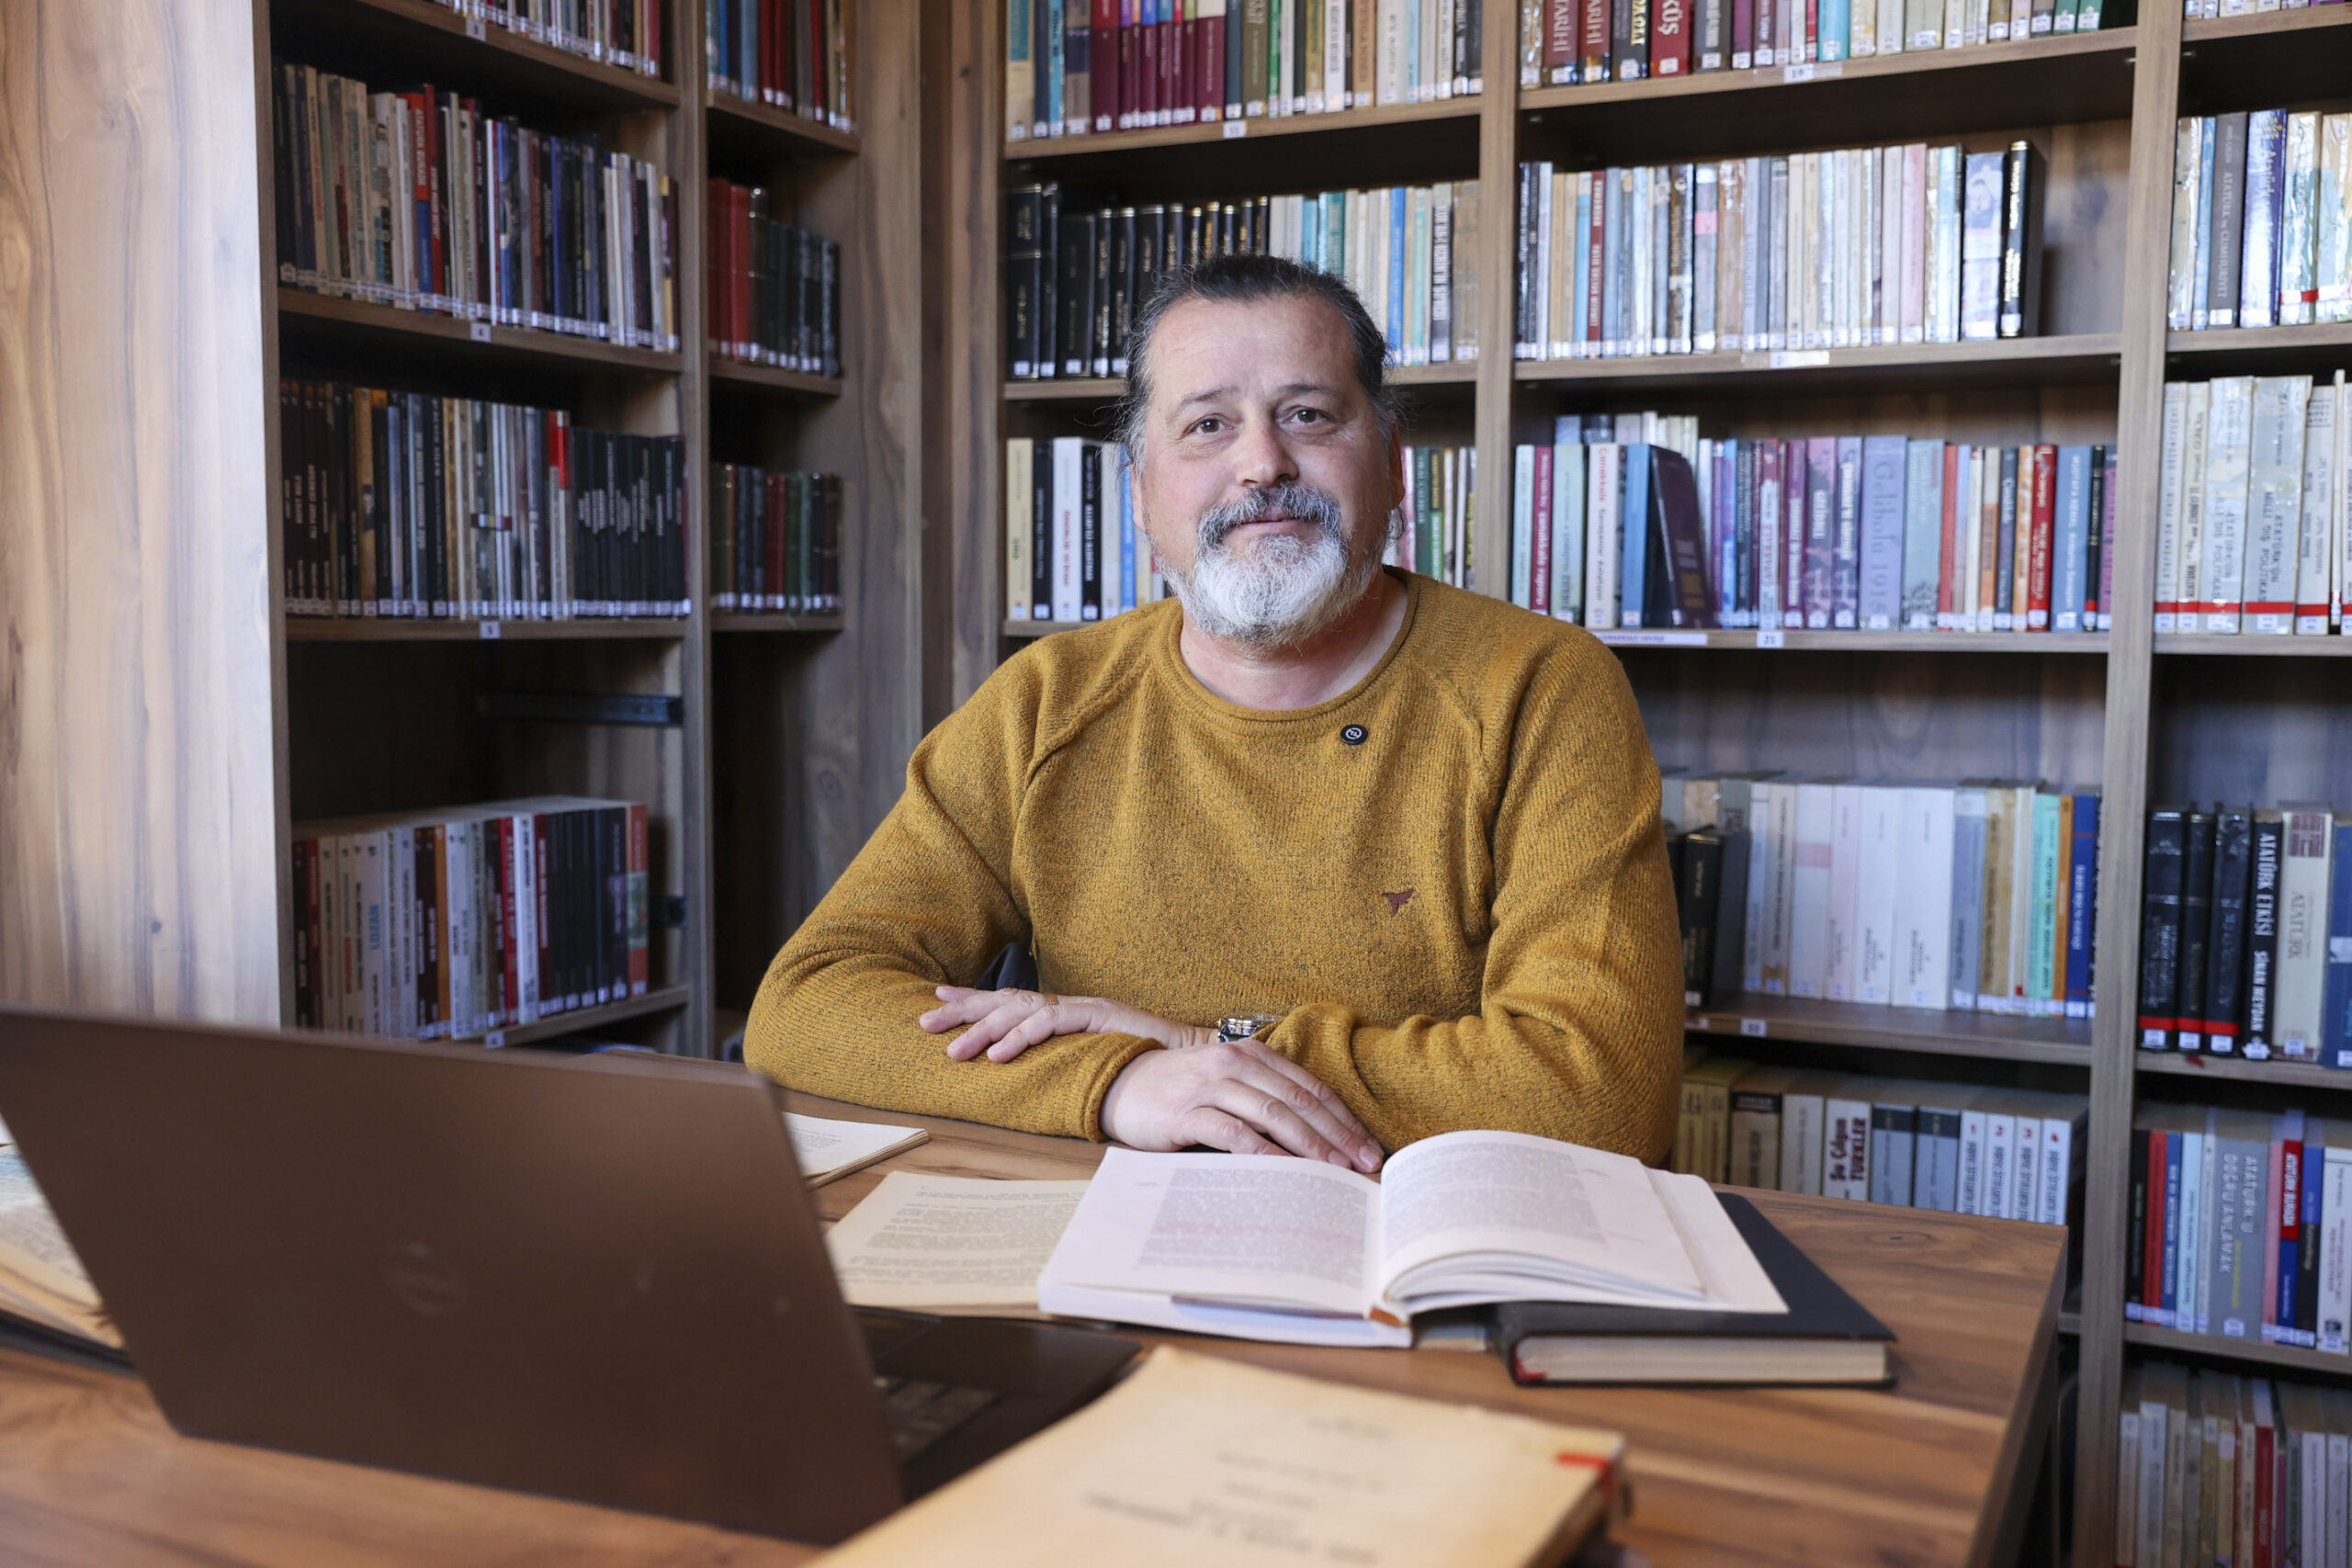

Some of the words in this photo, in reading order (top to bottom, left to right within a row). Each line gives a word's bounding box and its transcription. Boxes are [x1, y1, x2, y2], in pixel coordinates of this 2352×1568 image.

[1586, 0, 1604, 44] ARİHİ
[2221, 172, 2235, 216] ATATÜRK
[2257, 150, 2276, 199] Atatürk
[2217, 231, 2231, 298] CUMHURİYET
[1598, 447, 1609, 502] Çanakkale
[2069, 456, 2081, 496] MUSTAFA
[1871, 461, 1897, 555] Gelibolu
[2263, 491, 2275, 519] MİLLİ
[1536, 512, 1547, 566] çanakkale
[2261, 524, 2272, 542] DIŞ
[2271, 513, 2284, 583] ATATÜRK'ÜN
[1534, 569, 1545, 605] raporu
[1871, 563, 1888, 614] 1915
[2211, 545, 2222, 599] POLİTİKAS
[2257, 548, 2271, 603] POLİTİKAS
[2256, 833, 2278, 889] ATATÜRK
[368, 905, 380, 951] LOZAN
[2254, 895, 2276, 936] ETKİSİ
[2288, 890, 2306, 960] ATATÜRK
[2252, 950, 2270, 985] SİNAN
[2250, 987, 2267, 1032] MEYDAN
[2221, 1153, 2238, 1201] DOĞRU
[2284, 1152, 2299, 1191] ATATÜRK
[2282, 1191, 2297, 1227] BURADA
[2217, 1204, 2235, 1274] ANLAMAK
